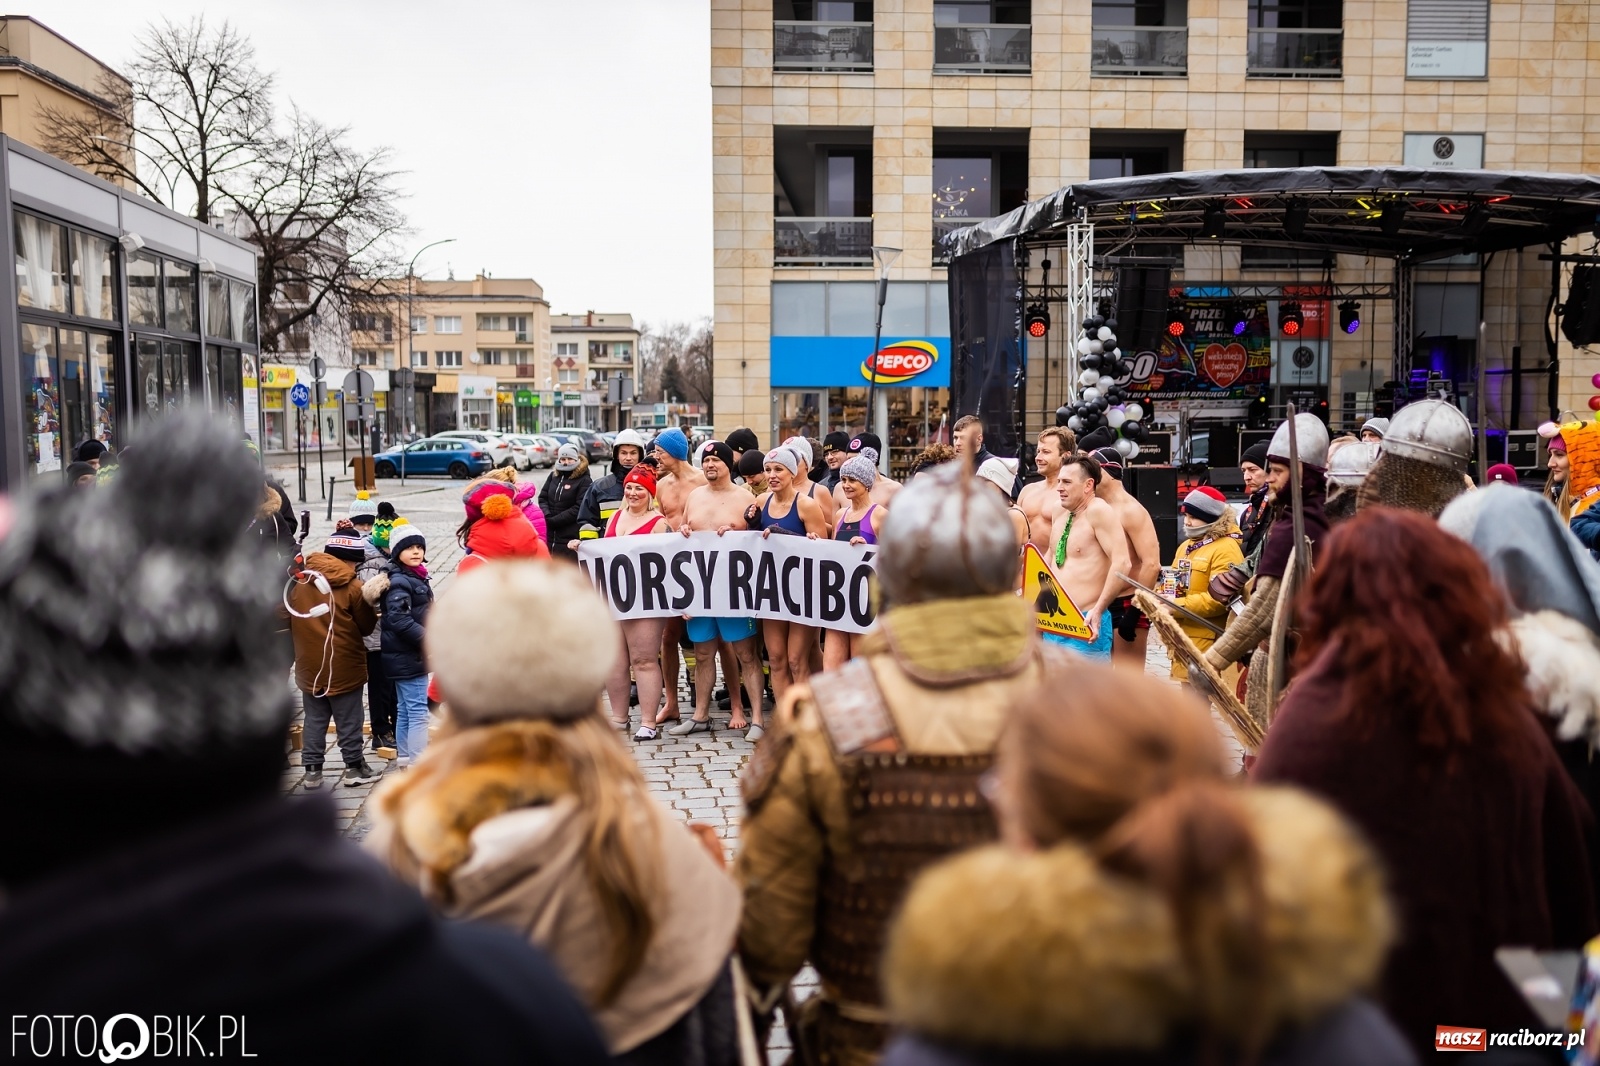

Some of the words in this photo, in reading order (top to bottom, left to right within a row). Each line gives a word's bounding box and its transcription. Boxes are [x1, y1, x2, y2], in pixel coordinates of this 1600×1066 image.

[934, 208, 969, 217] KOFEINKA
[1195, 321, 1214, 331] NA
[875, 354, 927, 369] PEPCO
[327, 537, 354, 546] LORE
[1052, 621, 1078, 632] MORSY
